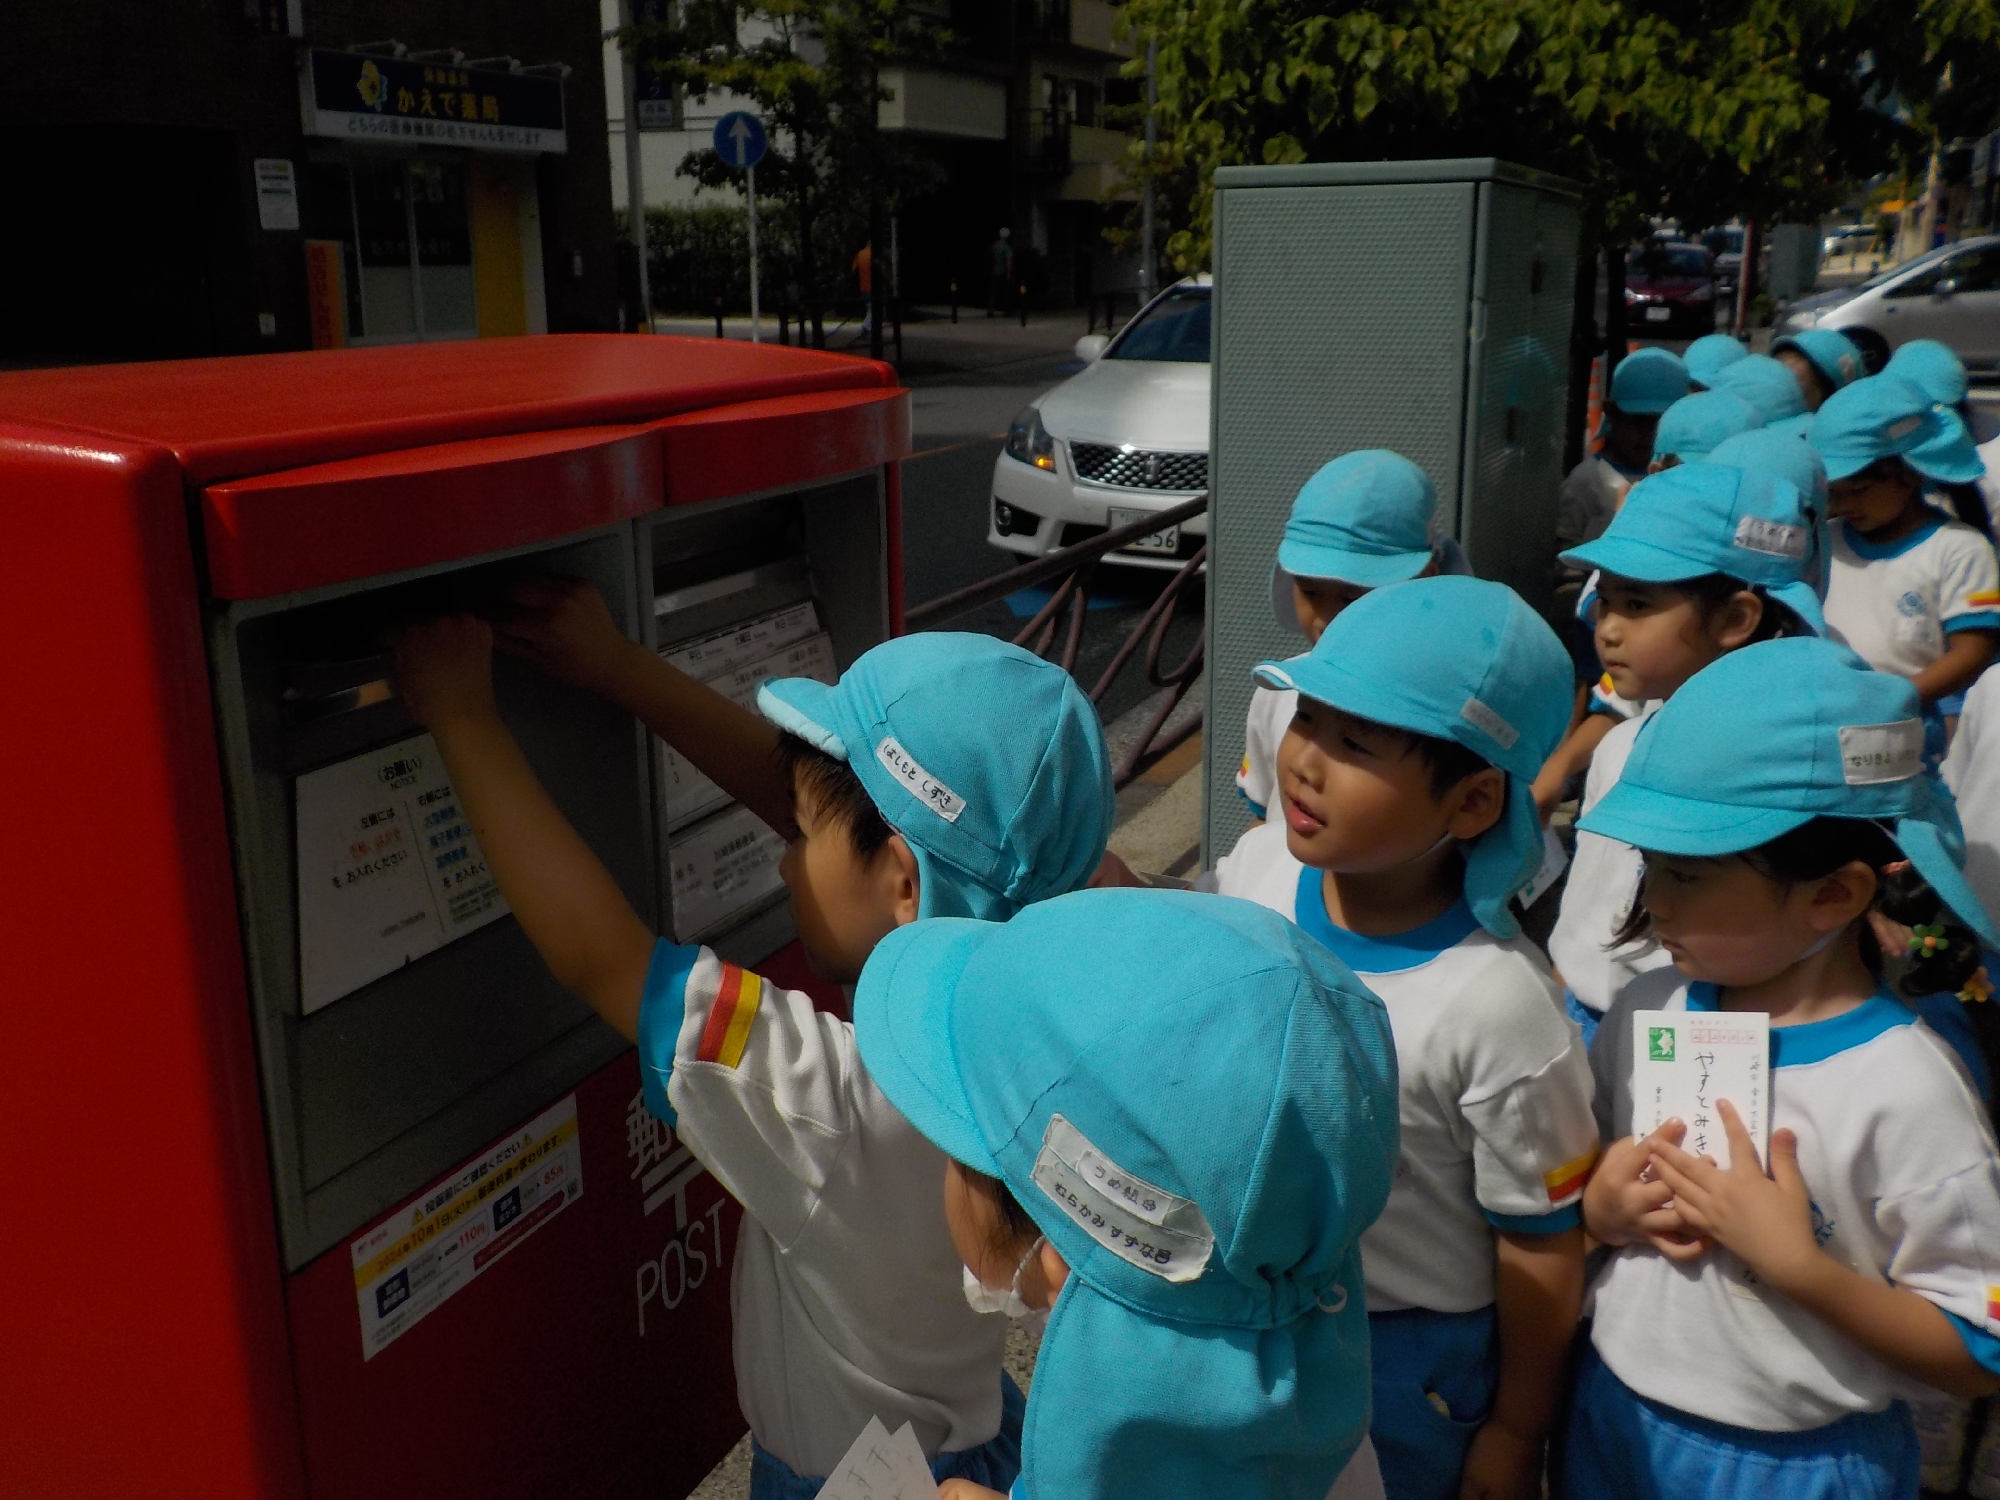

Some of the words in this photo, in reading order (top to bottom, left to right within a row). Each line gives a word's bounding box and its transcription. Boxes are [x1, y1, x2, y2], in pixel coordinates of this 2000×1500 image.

[396, 85, 501, 124] かえで薬局
[667, 752, 677, 767] 2
[673, 771, 682, 785] 3
[883, 743, 918, 781] はしもと
[390, 774, 418, 791] NOTICE
[416, 786, 452, 806] 右側には
[360, 807, 396, 829] 左側には
[345, 849, 409, 885] お入れください
[424, 1140, 522, 1213] 投函前にご確認ください
[1094, 1165, 1139, 1206] うめ組
[1053, 1182, 1106, 1229] むらかみ
[636, 1197, 726, 1338] POST
